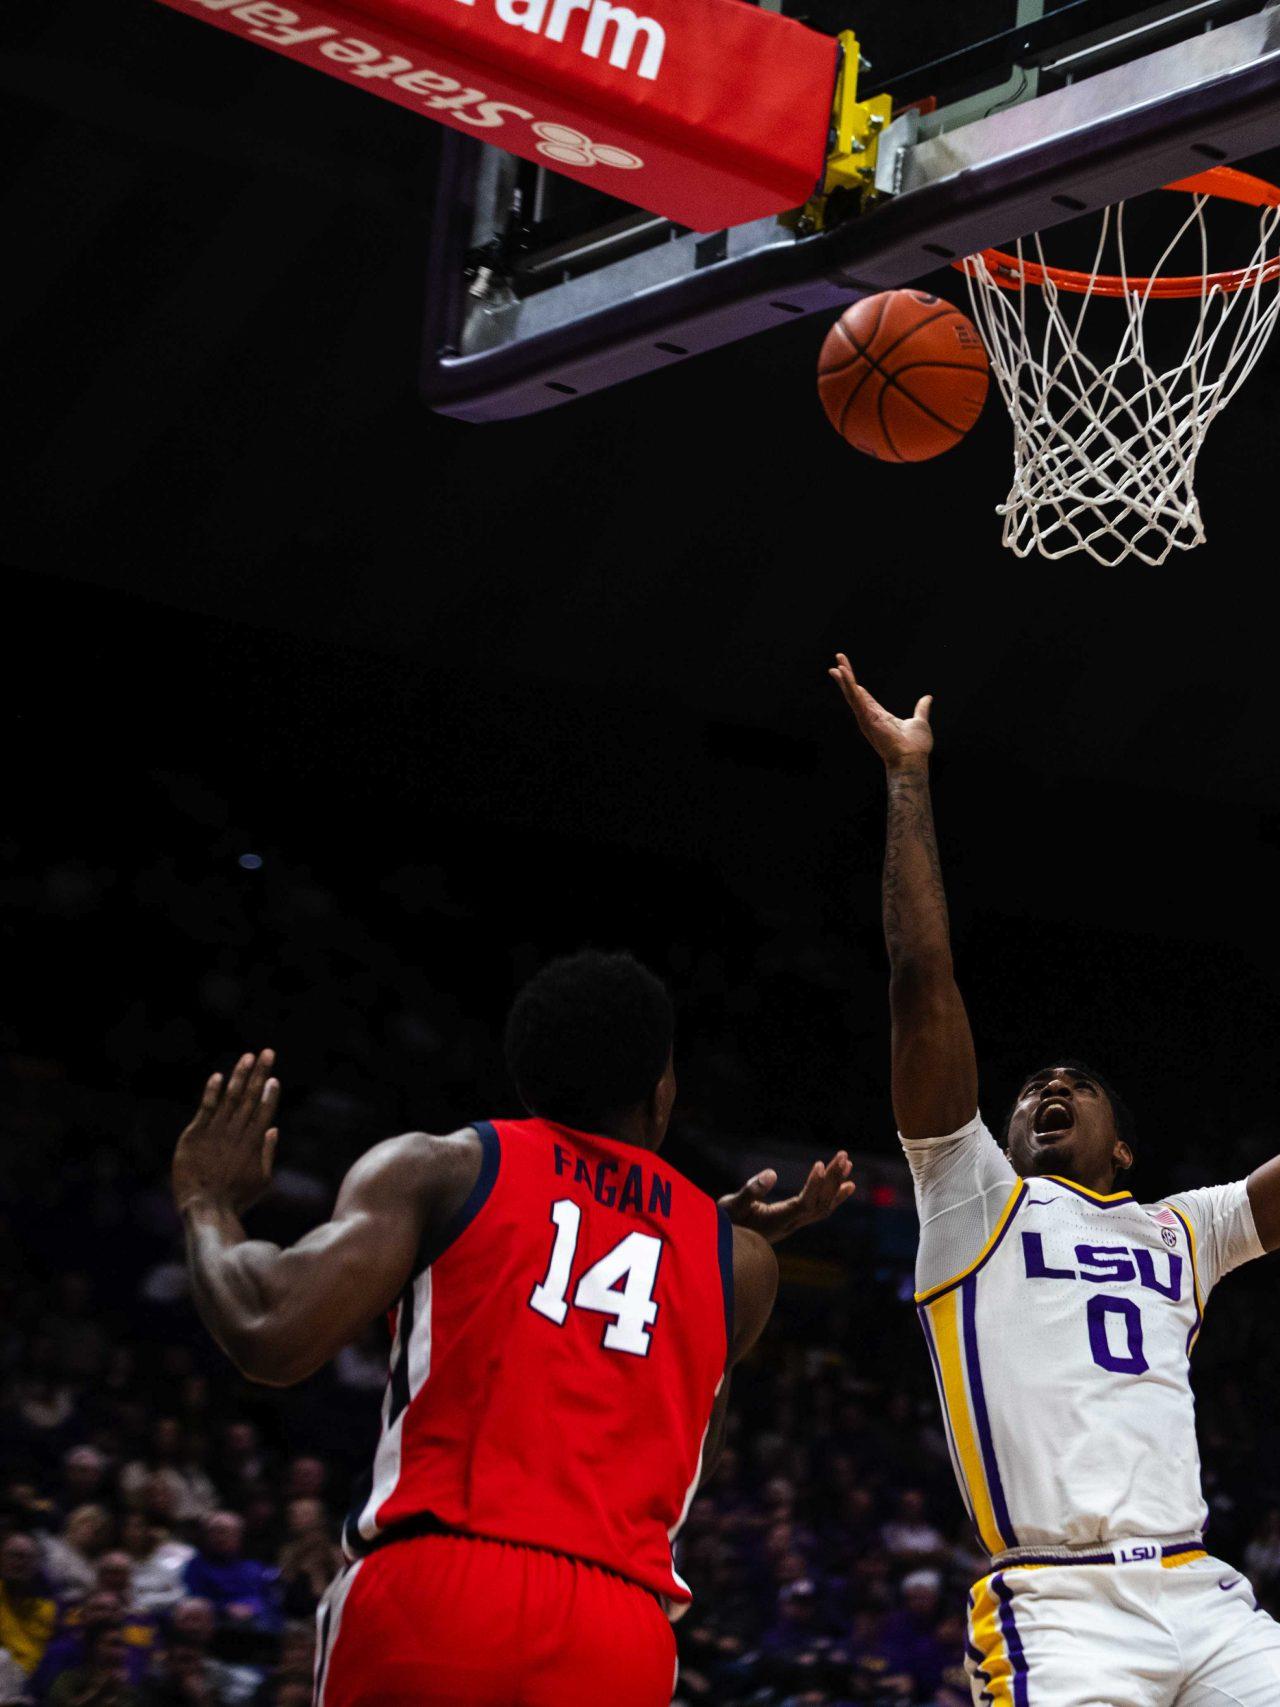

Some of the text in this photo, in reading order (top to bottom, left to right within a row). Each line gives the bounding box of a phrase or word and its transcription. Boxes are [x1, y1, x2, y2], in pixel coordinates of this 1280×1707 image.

[452, 0, 666, 81] arm
[554, 1143, 672, 1219] FAGAN
[528, 1198, 664, 1357] 14
[1021, 1231, 1183, 1302] LSU
[1086, 1293, 1150, 1376] 0
[1120, 1545, 1157, 1563] LSU
